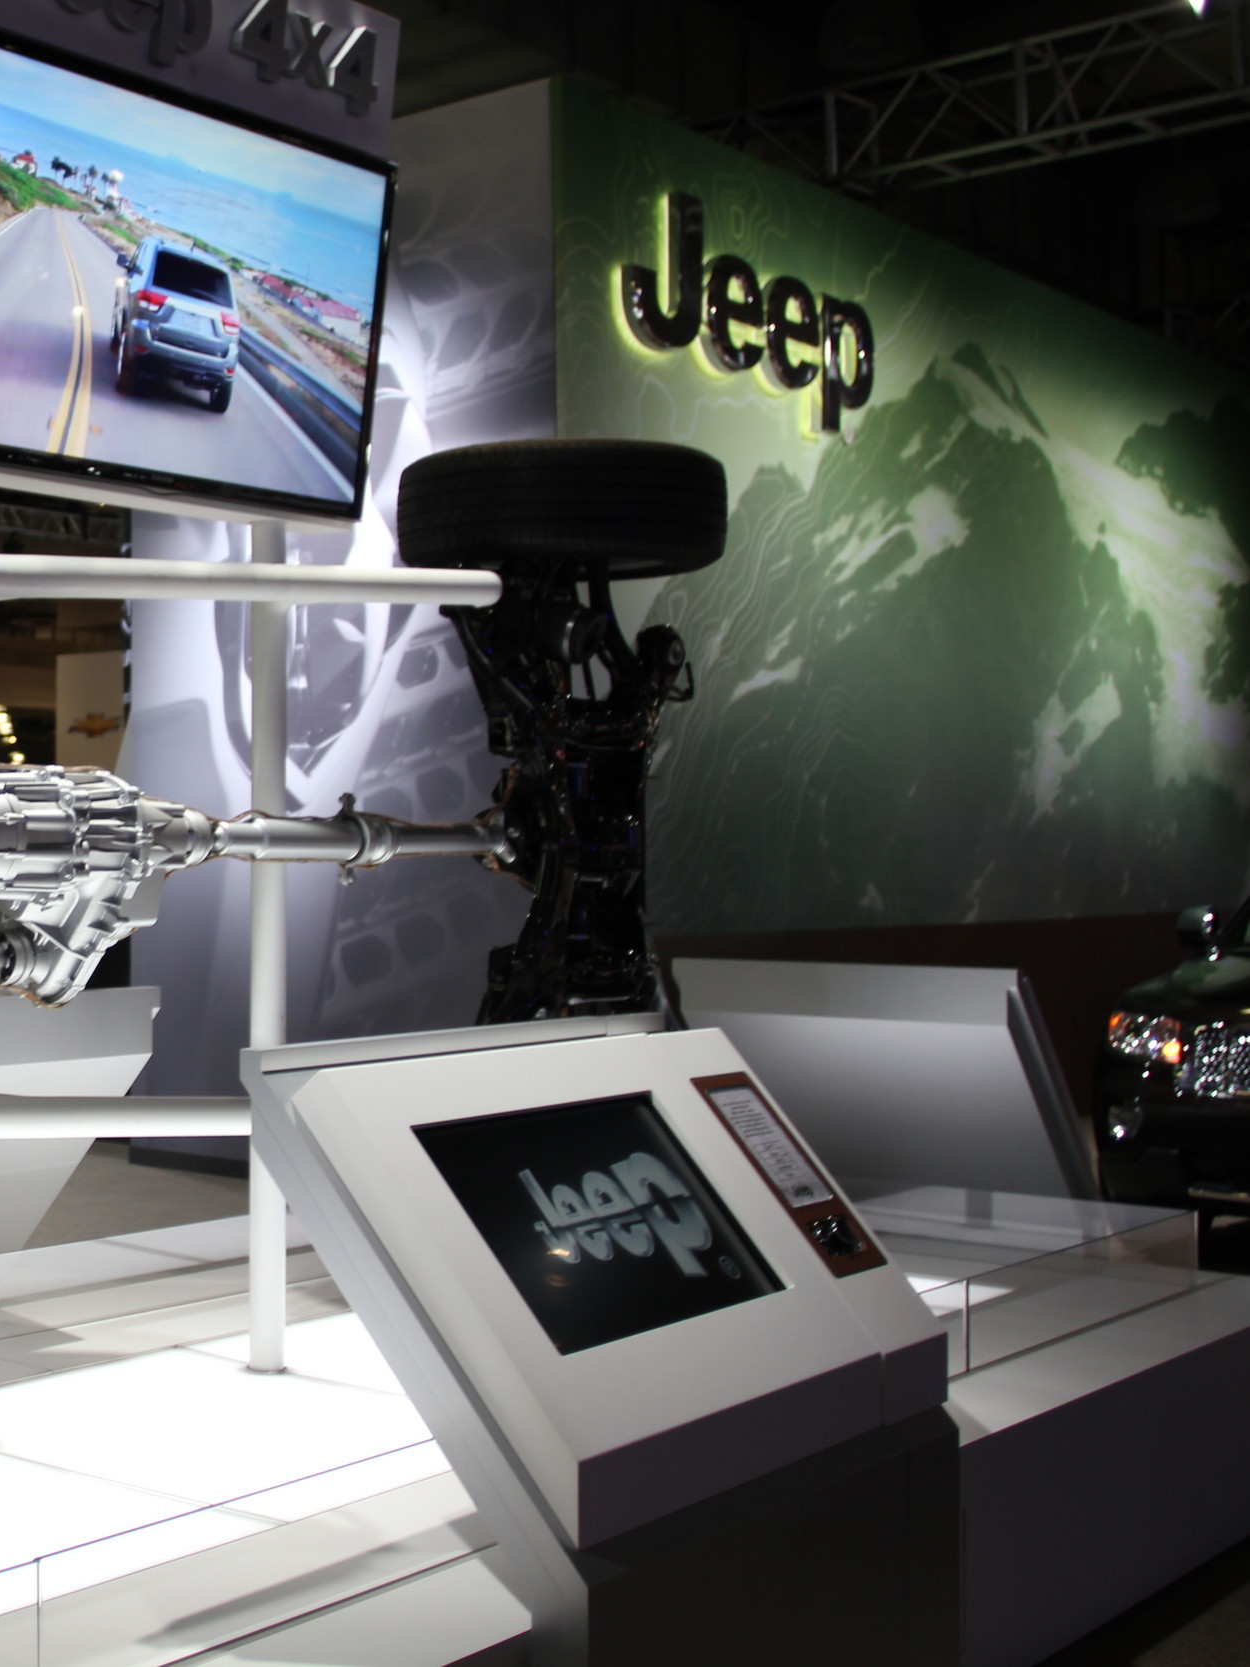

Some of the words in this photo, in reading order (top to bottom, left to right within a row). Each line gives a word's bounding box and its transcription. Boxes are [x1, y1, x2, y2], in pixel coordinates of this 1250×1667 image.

[230, 0, 378, 117] 4x4
[618, 192, 874, 433] Jeep
[517, 1151, 714, 1278] Jeep
